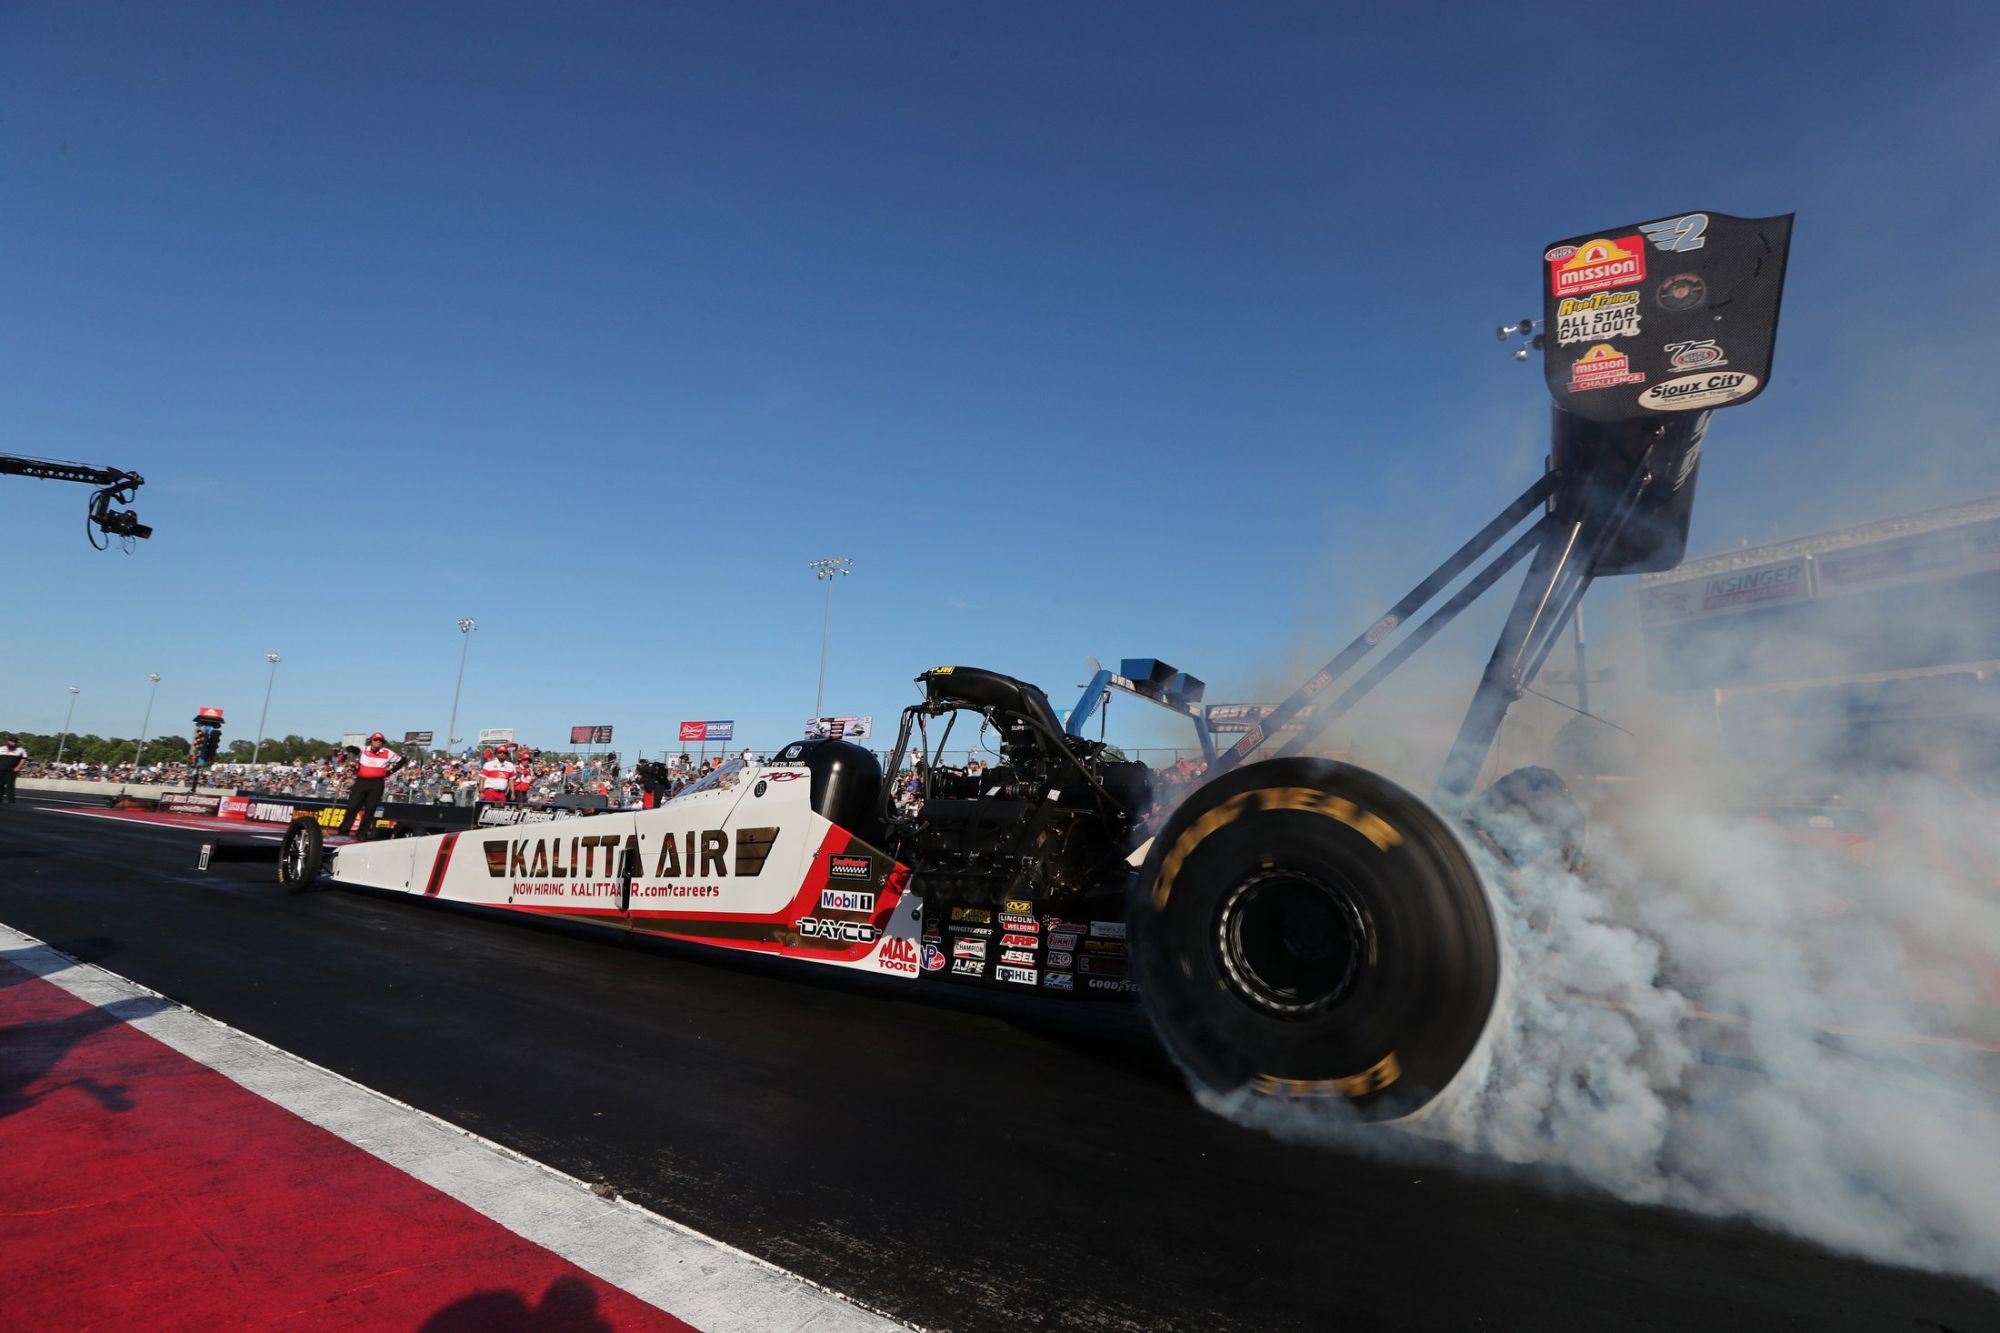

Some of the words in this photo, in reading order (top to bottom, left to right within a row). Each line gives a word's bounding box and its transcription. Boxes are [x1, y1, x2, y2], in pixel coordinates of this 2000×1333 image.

[1673, 213, 1709, 252] 2
[1560, 314, 1589, 330] ALL
[1593, 307, 1634, 324] STAR
[1560, 318, 1635, 340] CALLOUT
[1579, 374, 1642, 389] CHALLENGE
[1650, 381, 1702, 398] Sioux
[1707, 374, 1746, 391] City
[1704, 564, 1801, 596] INSINGER
[318, 808, 347, 828] JEGS
[510, 835, 645, 878] KALITTA
[655, 830, 729, 878] AIR
[513, 883, 534, 896] NOW
[535, 883, 564, 896] HIRING
[571, 882, 720, 897] KALITTAAR.com/careers
[823, 891, 858, 910] Mobil
[861, 895, 872, 910] 1
[1000, 914, 1033, 924] LINCOLN
[1007, 922, 1036, 932] WELDERS
[800, 916, 878, 943] DAYCO
[879, 938, 917, 963] MAC
[955, 943, 984, 954] CHAMPION
[1002, 935, 1037, 947] ARP
[878, 959, 917, 973] TOOLS
[920, 944, 938, 969] VP
[951, 959, 986, 973] AJPE
[1001, 950, 1036, 963] JESEL
[1088, 978, 1143, 993] GOODYE
